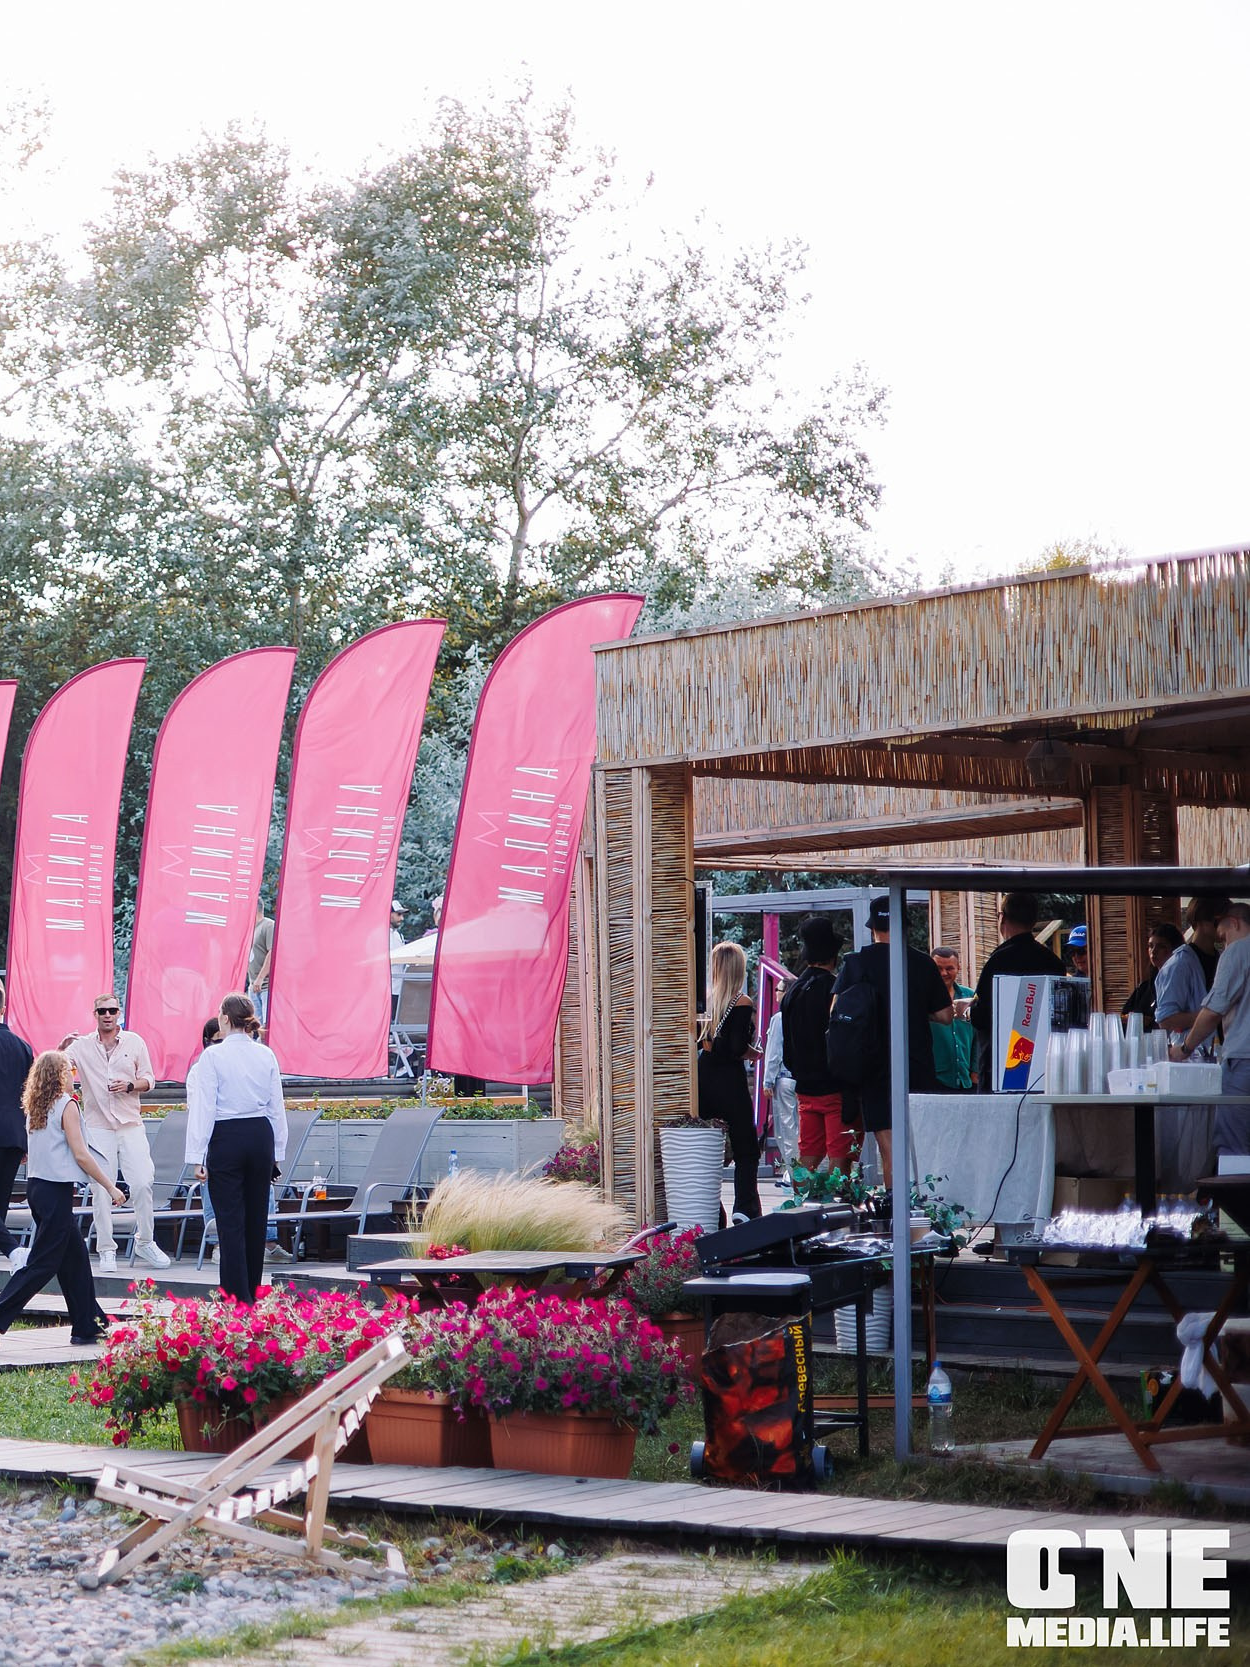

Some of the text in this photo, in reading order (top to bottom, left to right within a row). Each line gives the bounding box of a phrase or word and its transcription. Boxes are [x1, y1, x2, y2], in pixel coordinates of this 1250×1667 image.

[45, 814, 89, 931] МАЛИНА
[87, 844, 104, 904] GLAMPING
[184, 804, 239, 927] МАЛИНА
[234, 837, 255, 899] GLAMPING
[319, 784, 383, 909] МАЛИНА
[497, 766, 559, 905] МАЛИНА
[552, 803, 573, 874] GLAMPING
[1022, 983, 1037, 1027] Red Bull
